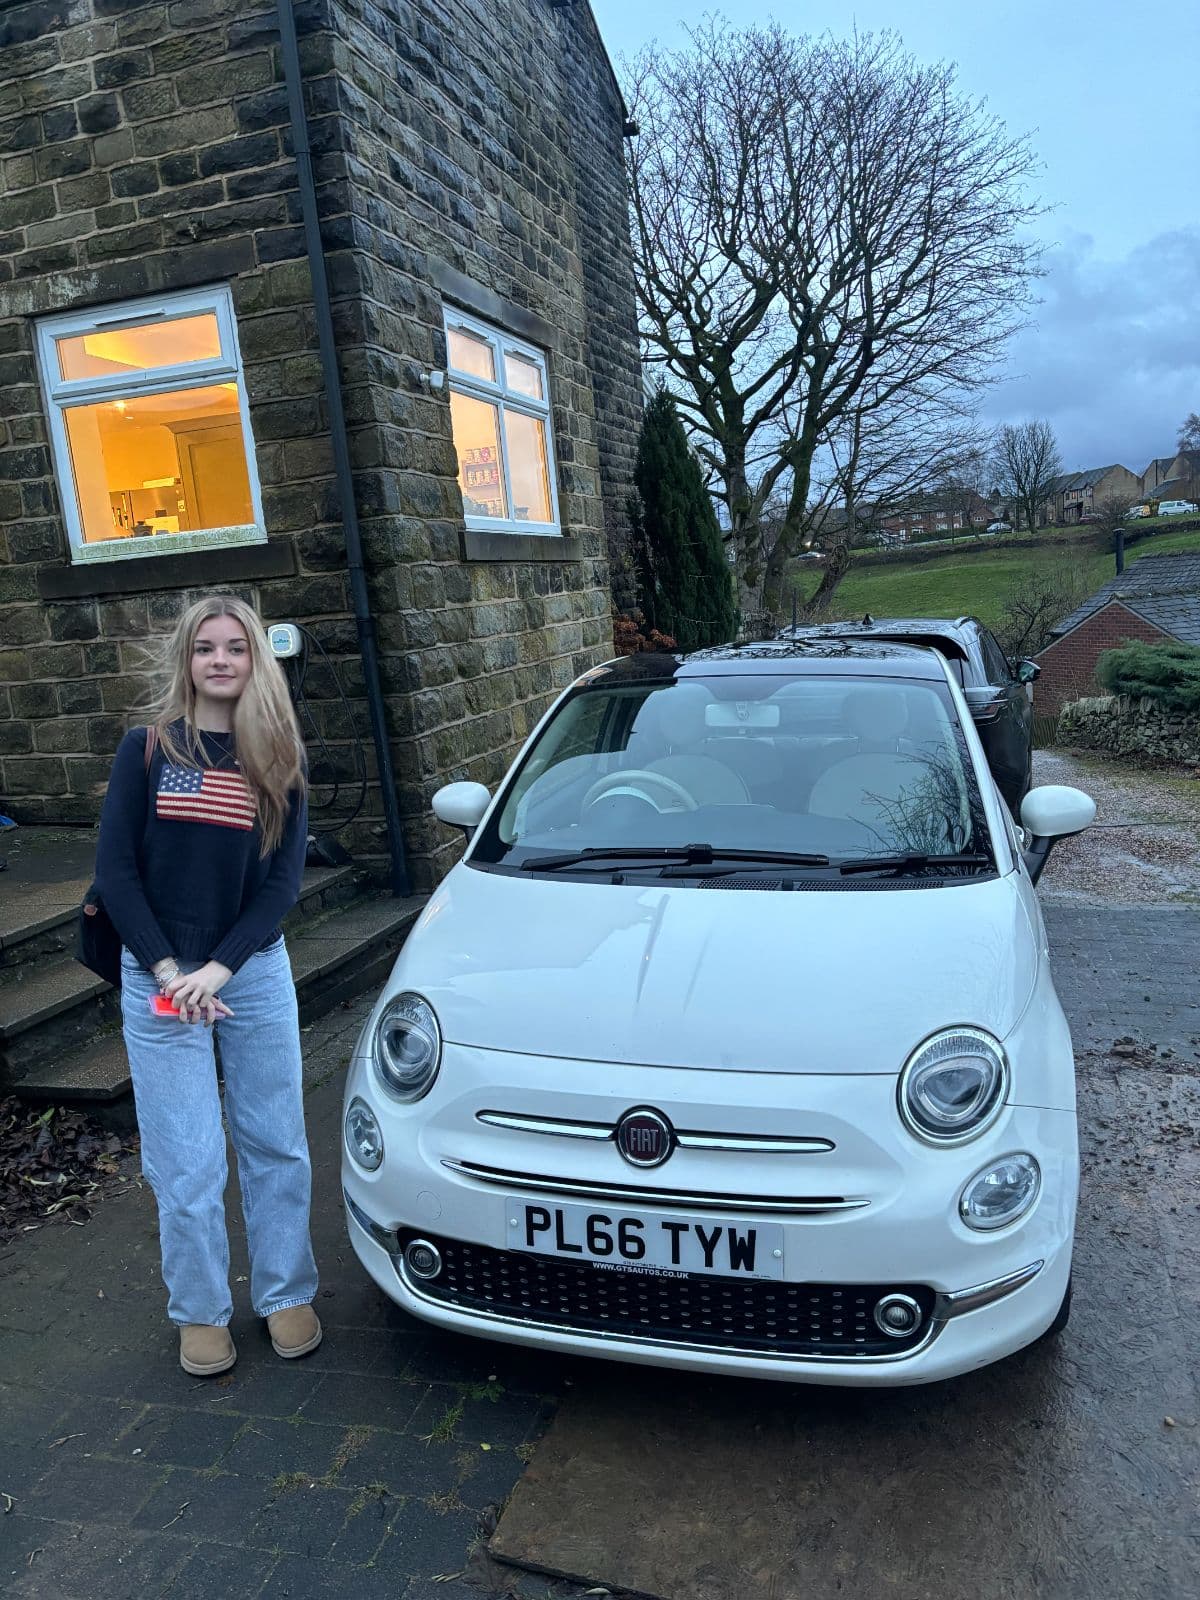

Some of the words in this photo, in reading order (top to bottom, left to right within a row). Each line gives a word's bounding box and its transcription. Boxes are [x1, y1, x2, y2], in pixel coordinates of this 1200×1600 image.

[630, 1128, 659, 1152] FIAT
[525, 1205, 646, 1260] PL66
[661, 1221, 757, 1272] TYW
